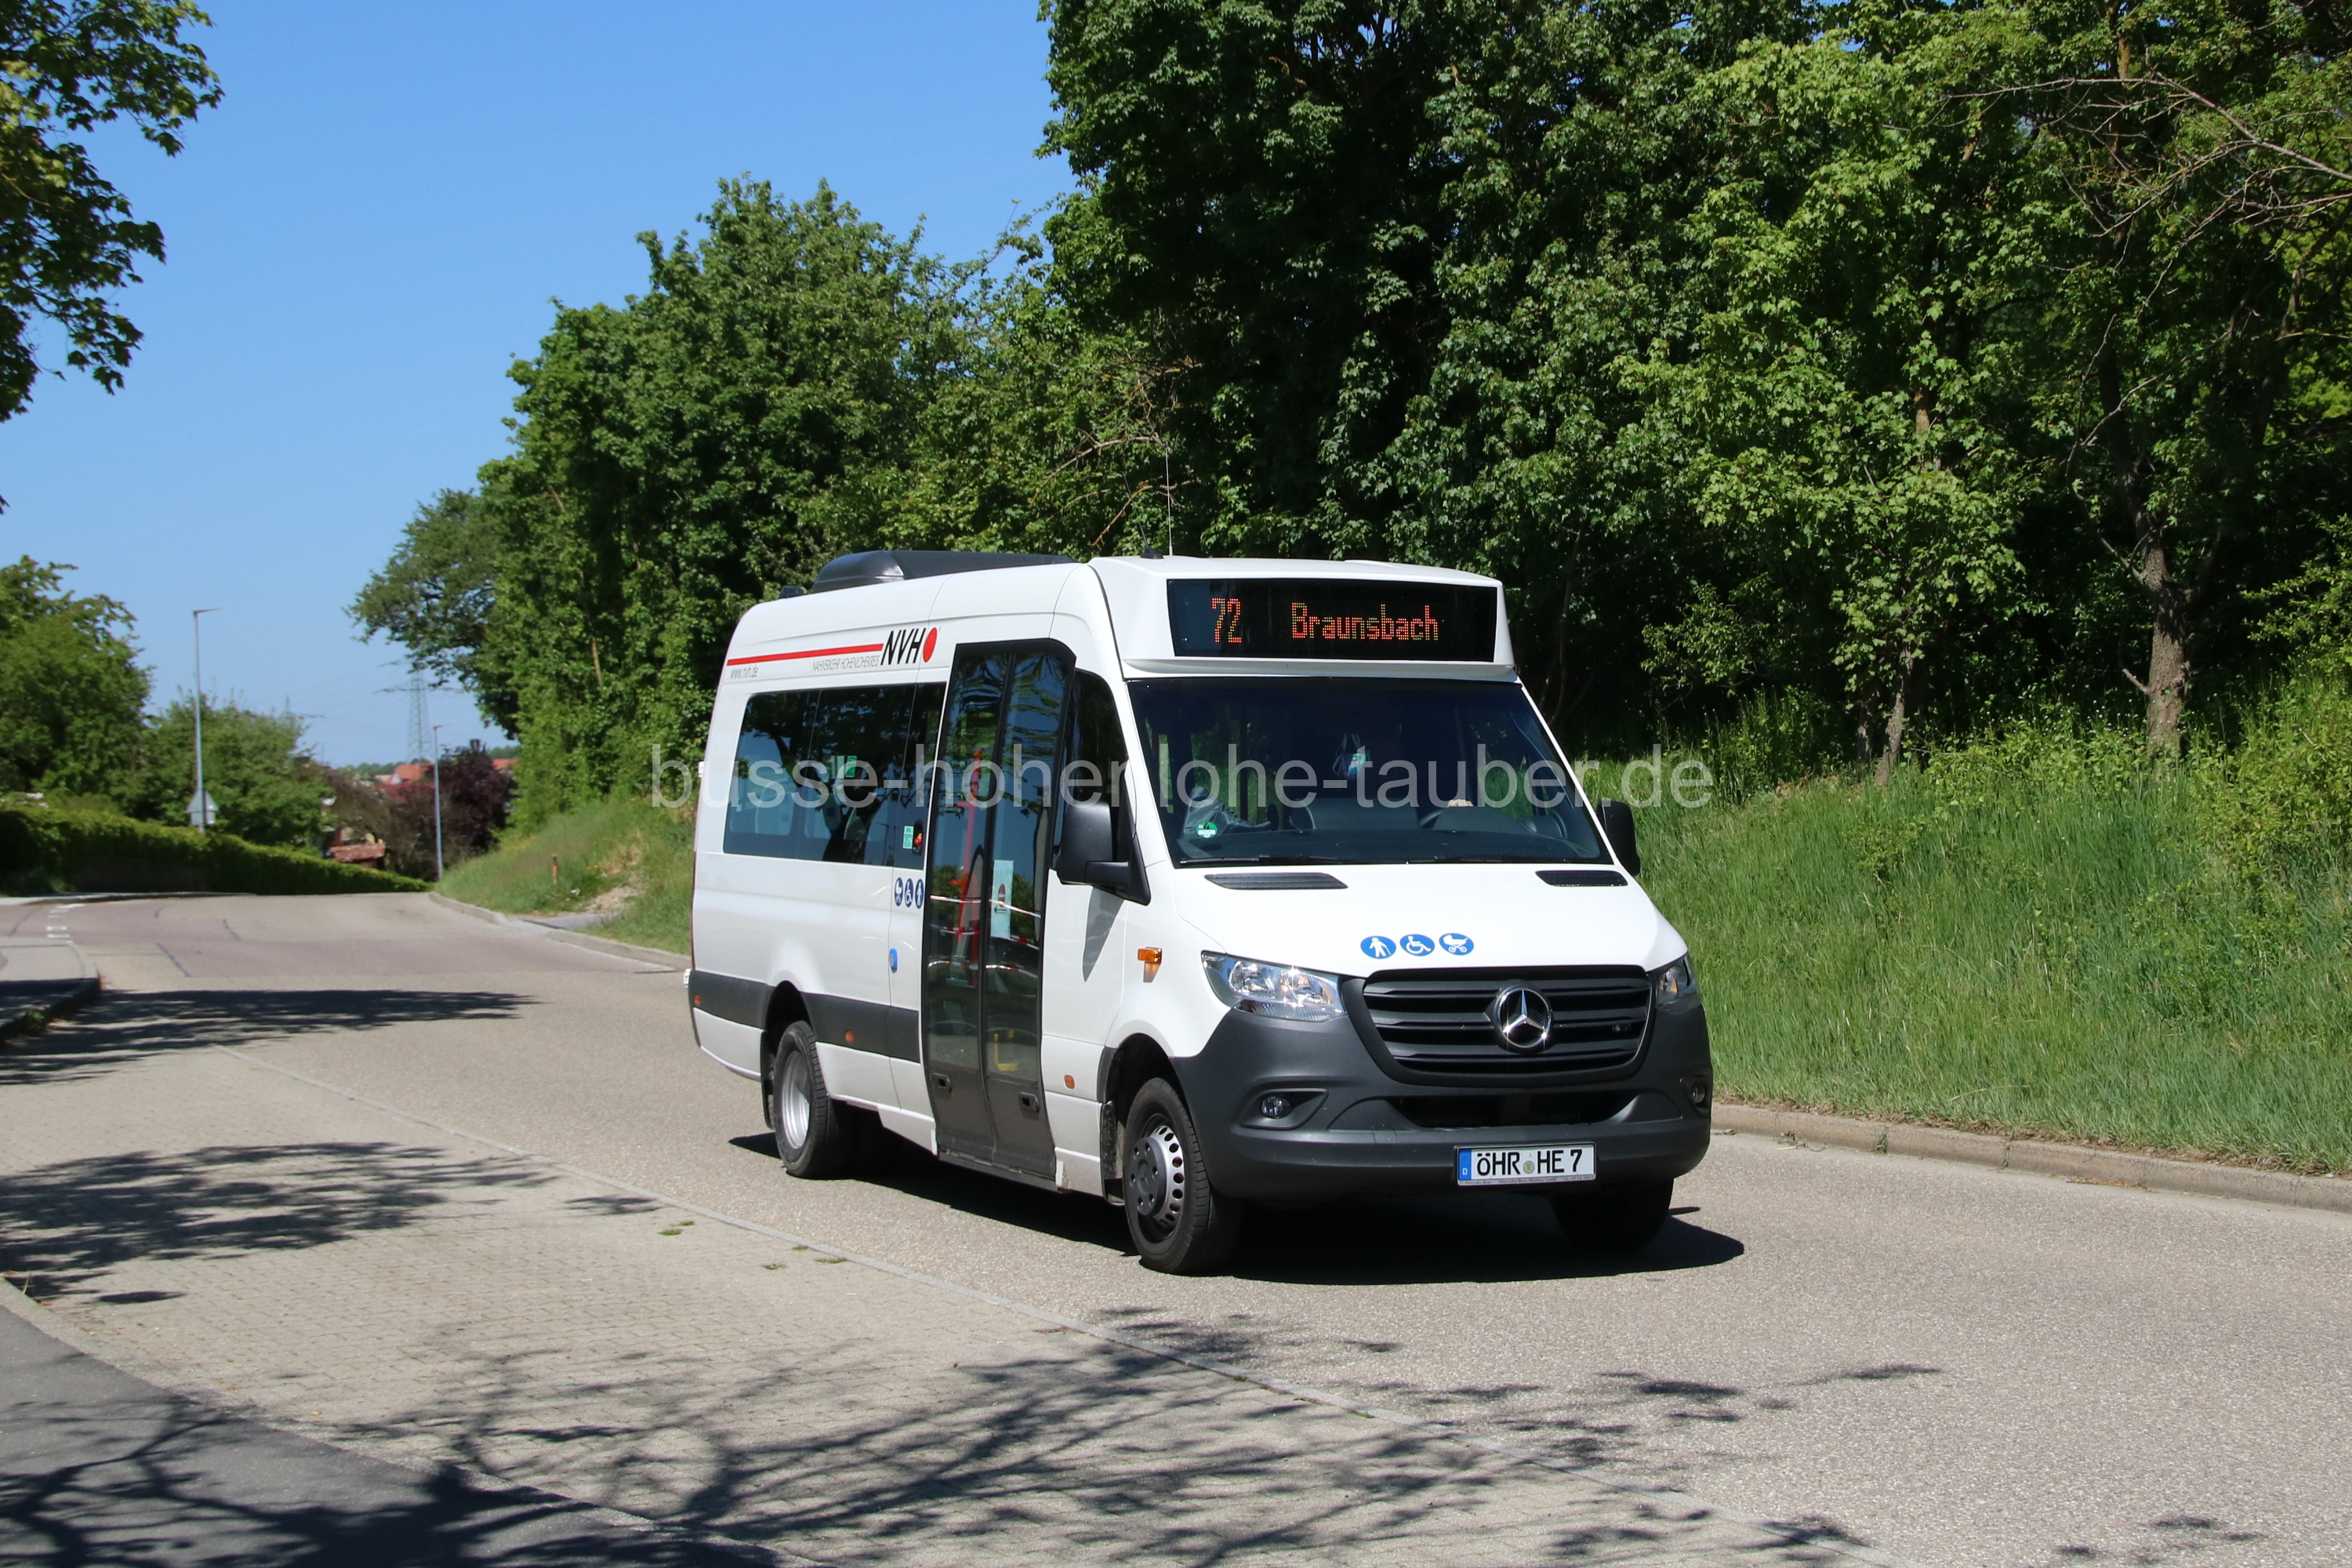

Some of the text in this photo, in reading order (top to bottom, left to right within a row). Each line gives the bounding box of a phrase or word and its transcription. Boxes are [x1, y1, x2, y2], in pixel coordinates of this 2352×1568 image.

[1210, 597, 1439, 644] 72 Braunsbach
[880, 627, 927, 666] NVH
[1200, 822, 1210, 830] 4
[1476, 1152, 1521, 1176] ÖHR
[1537, 1149, 1565, 1174] HE
[1570, 1149, 1582, 1173] 7
